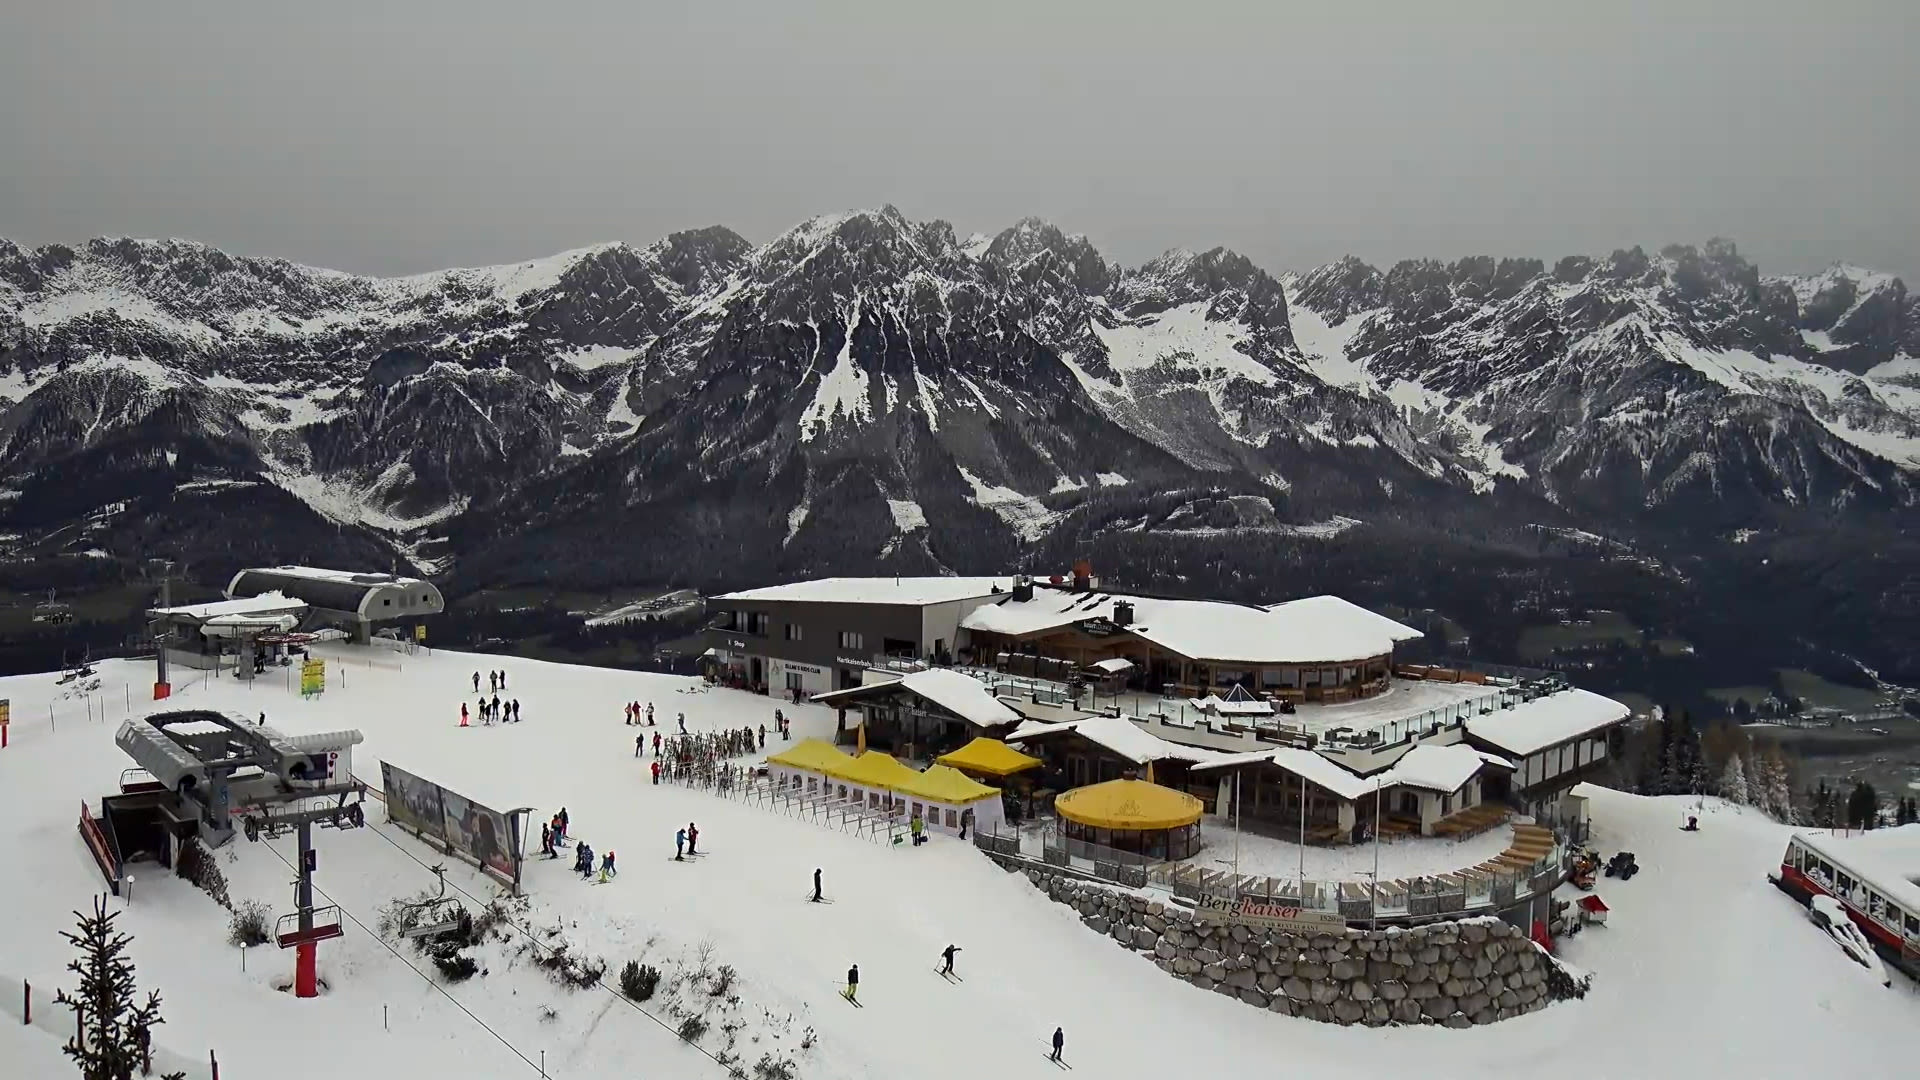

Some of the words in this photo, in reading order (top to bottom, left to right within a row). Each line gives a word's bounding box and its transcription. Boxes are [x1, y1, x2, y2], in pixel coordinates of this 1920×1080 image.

[810, 666, 821, 674] CLUB
[1199, 893, 1302, 918] Bergkaiser
[1319, 914, 1336, 922] 1520
